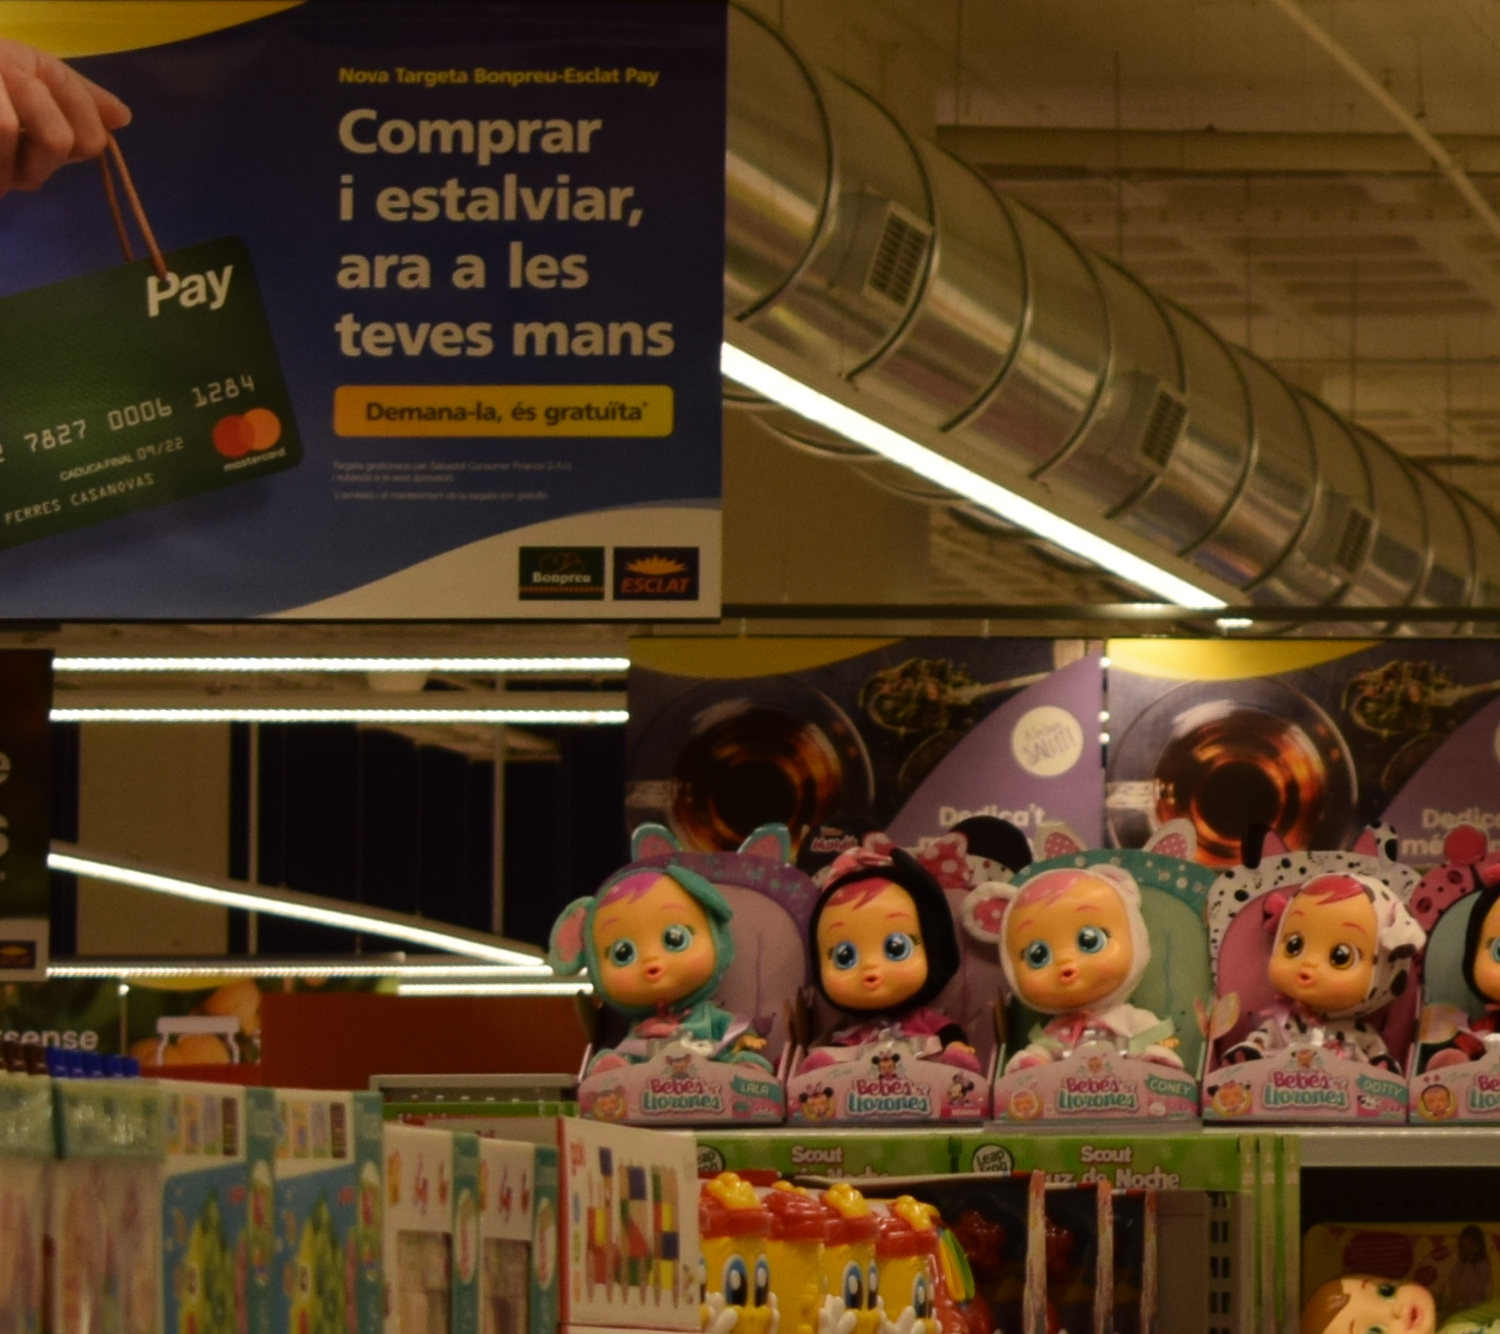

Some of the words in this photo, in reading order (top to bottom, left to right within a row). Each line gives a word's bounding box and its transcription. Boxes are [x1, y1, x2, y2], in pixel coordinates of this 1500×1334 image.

[338, 68, 390, 85] Nova
[395, 68, 468, 88] Targeta
[474, 67, 619, 88] Bonpreu-Esclat
[626, 68, 660, 88] Pay
[338, 109, 602, 165] Comprar
[339, 174, 354, 221] i
[375, 174, 644, 228] estalviar,
[336, 252, 431, 289] ara
[452, 252, 487, 289] a
[510, 241, 590, 289] les
[146, 265, 234, 318] Pay
[334, 314, 494, 357] teves
[512, 319, 676, 358] mans
[24, 419, 88, 454] 7827
[107, 398, 173, 432] 0006
[191, 374, 255, 408] 1284
[365, 402, 503, 427] Demana-la,
[511, 400, 538, 424] és
[532, 571, 591, 585] Bonpreu
[620, 577, 692, 594] ESCLAT
[790, 1145, 844, 1164] Scout
[1080, 1146, 1133, 1164] Scout
